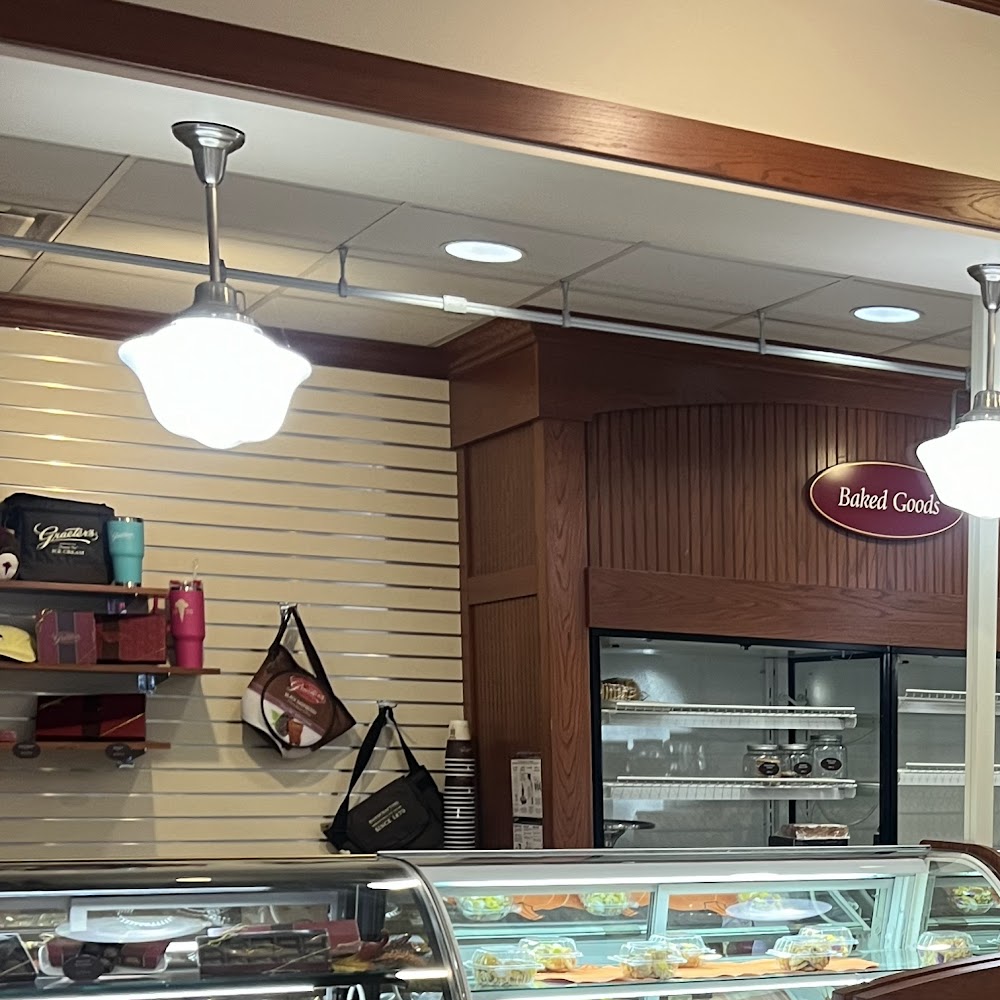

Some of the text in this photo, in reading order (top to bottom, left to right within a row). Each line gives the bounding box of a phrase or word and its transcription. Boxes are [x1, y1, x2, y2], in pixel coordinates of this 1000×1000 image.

[838, 486, 941, 515] Baked Goods
[33, 522, 98, 550] Graeter's
